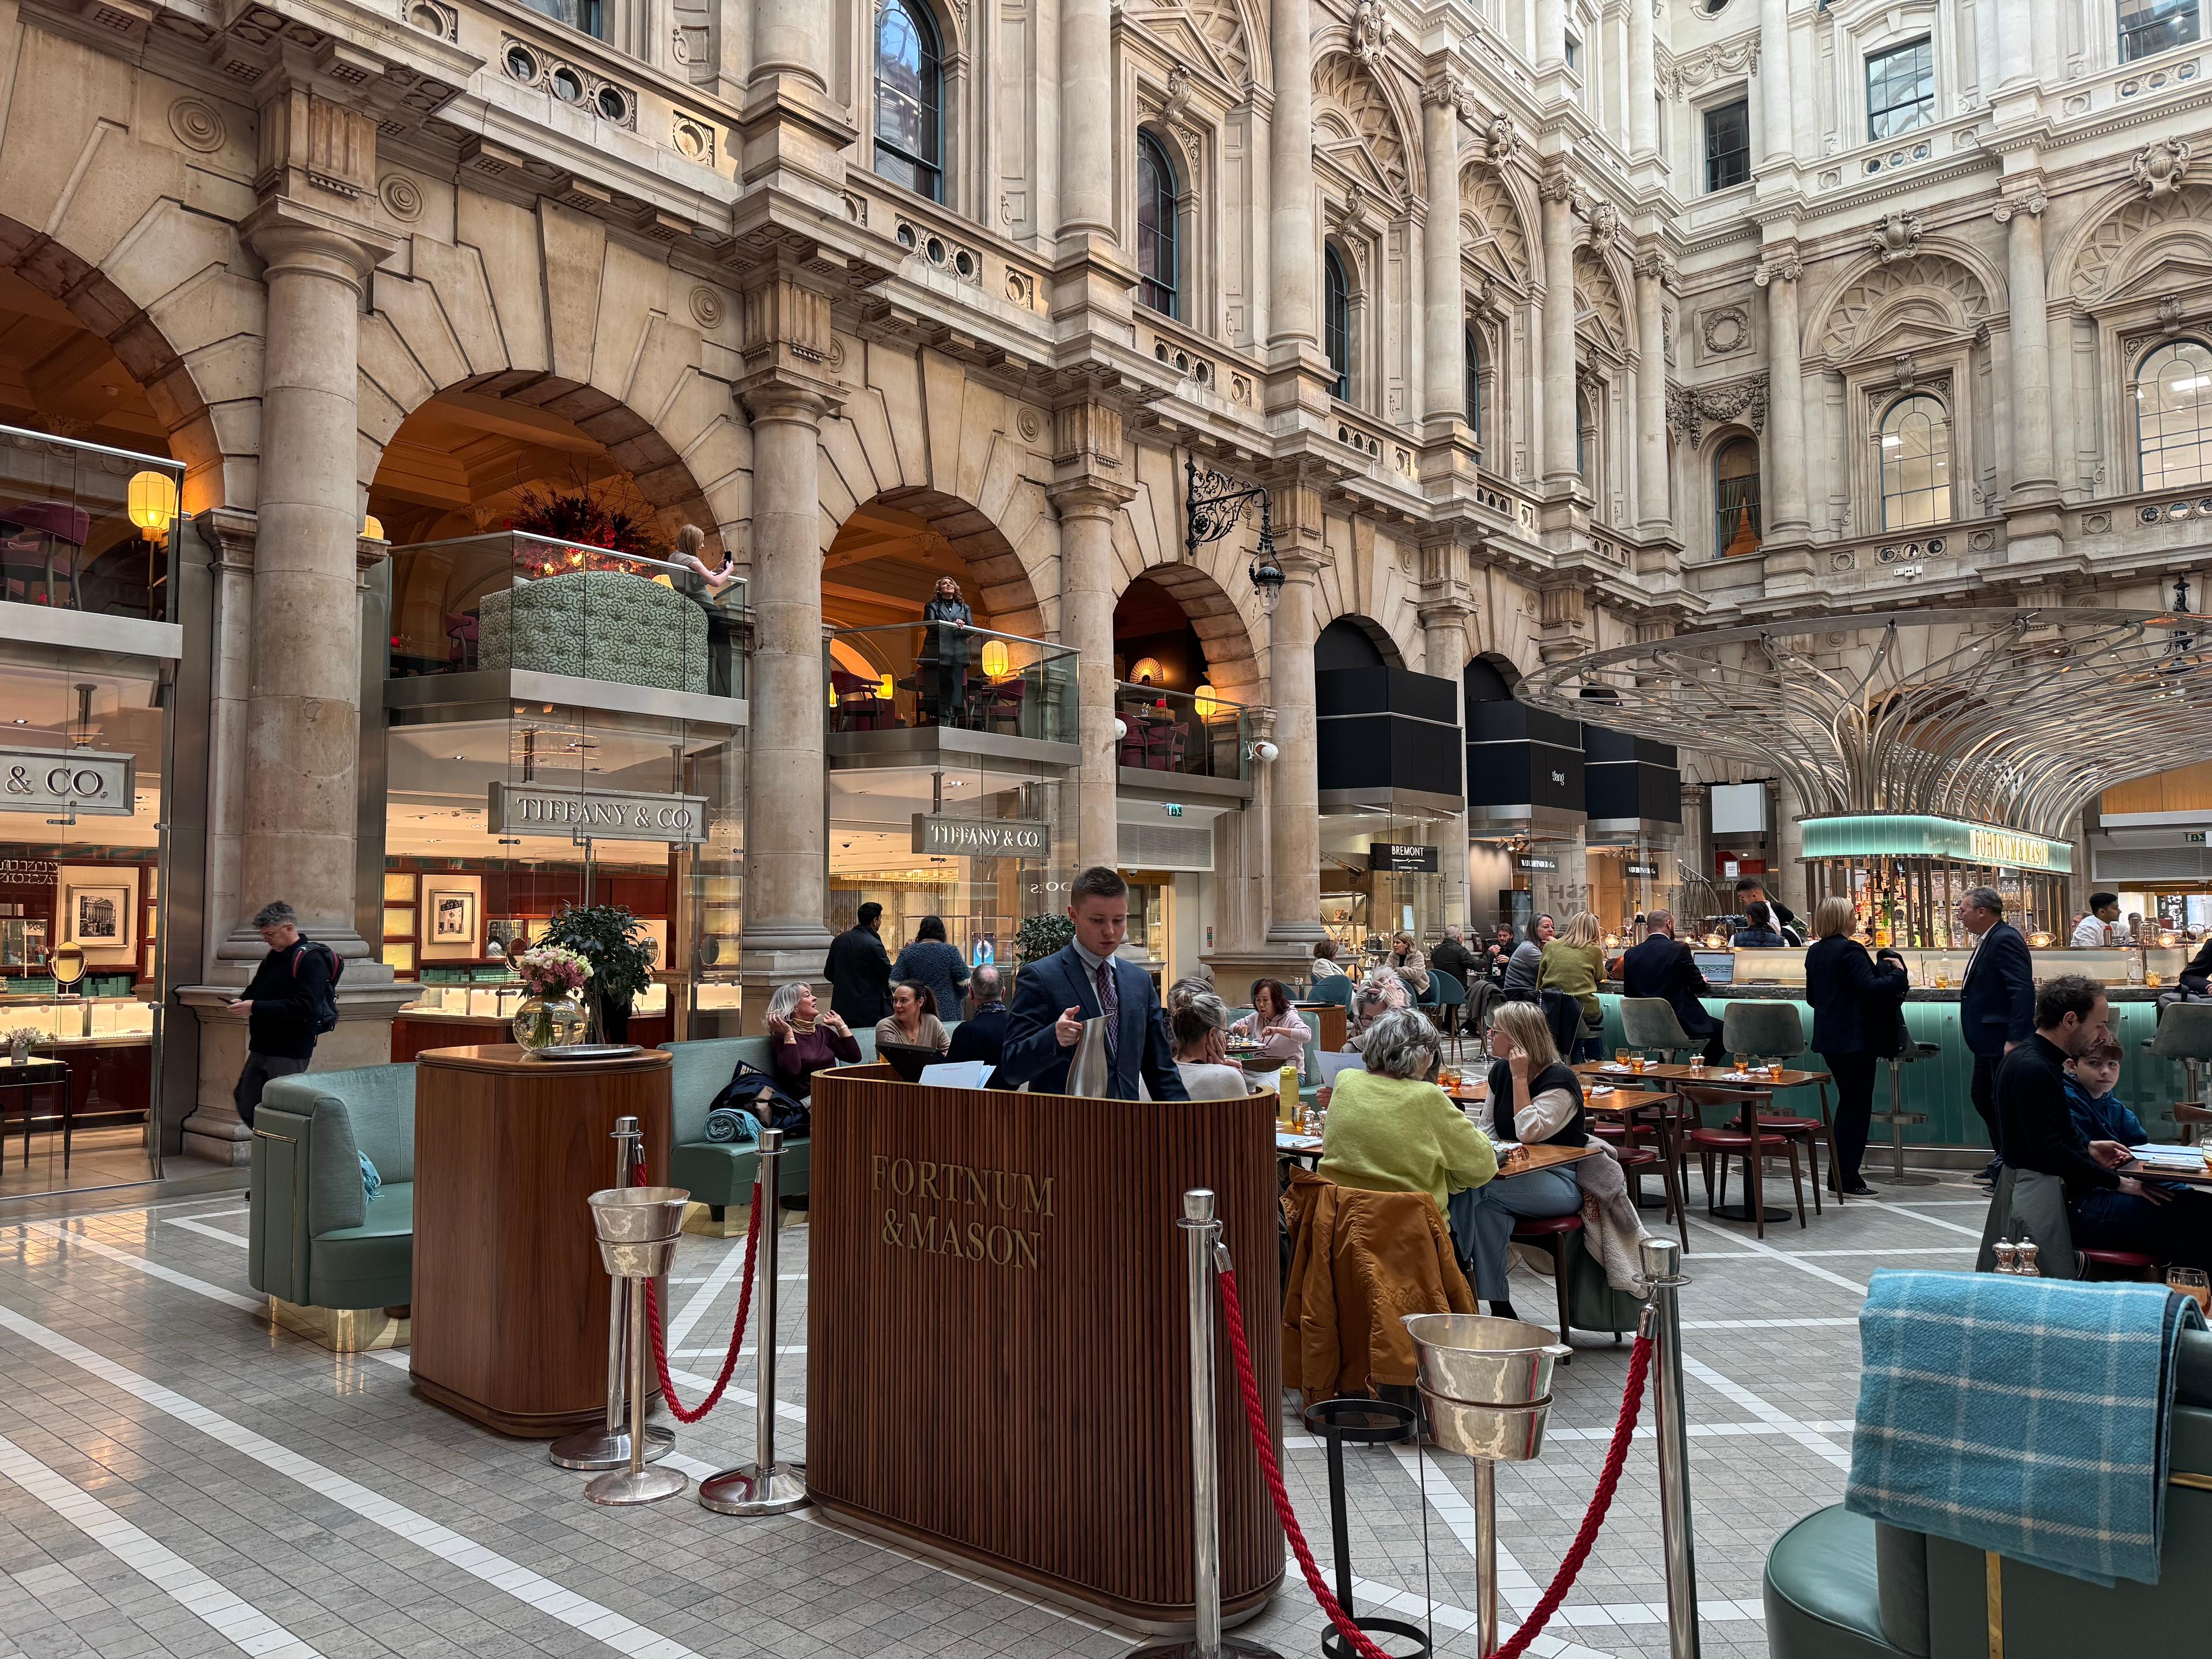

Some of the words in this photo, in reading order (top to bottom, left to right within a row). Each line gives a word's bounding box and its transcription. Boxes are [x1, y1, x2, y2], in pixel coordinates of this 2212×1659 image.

[5, 766, 35, 794] &
[45, 768, 108, 798] CO.
[516, 798, 631, 825] TIFFANY
[635, 806, 652, 828] &
[657, 807, 694, 830] CO.
[931, 825, 999, 846] TIFFANY
[1003, 830, 1013, 847] &
[1017, 831, 1040, 847] CO.
[1391, 846, 1424, 857] BREMONT
[1975, 830, 2016, 861] FORTNUM
[2025, 839, 2049, 866] MASON
[872, 1154, 1055, 1217] FORTNUM
